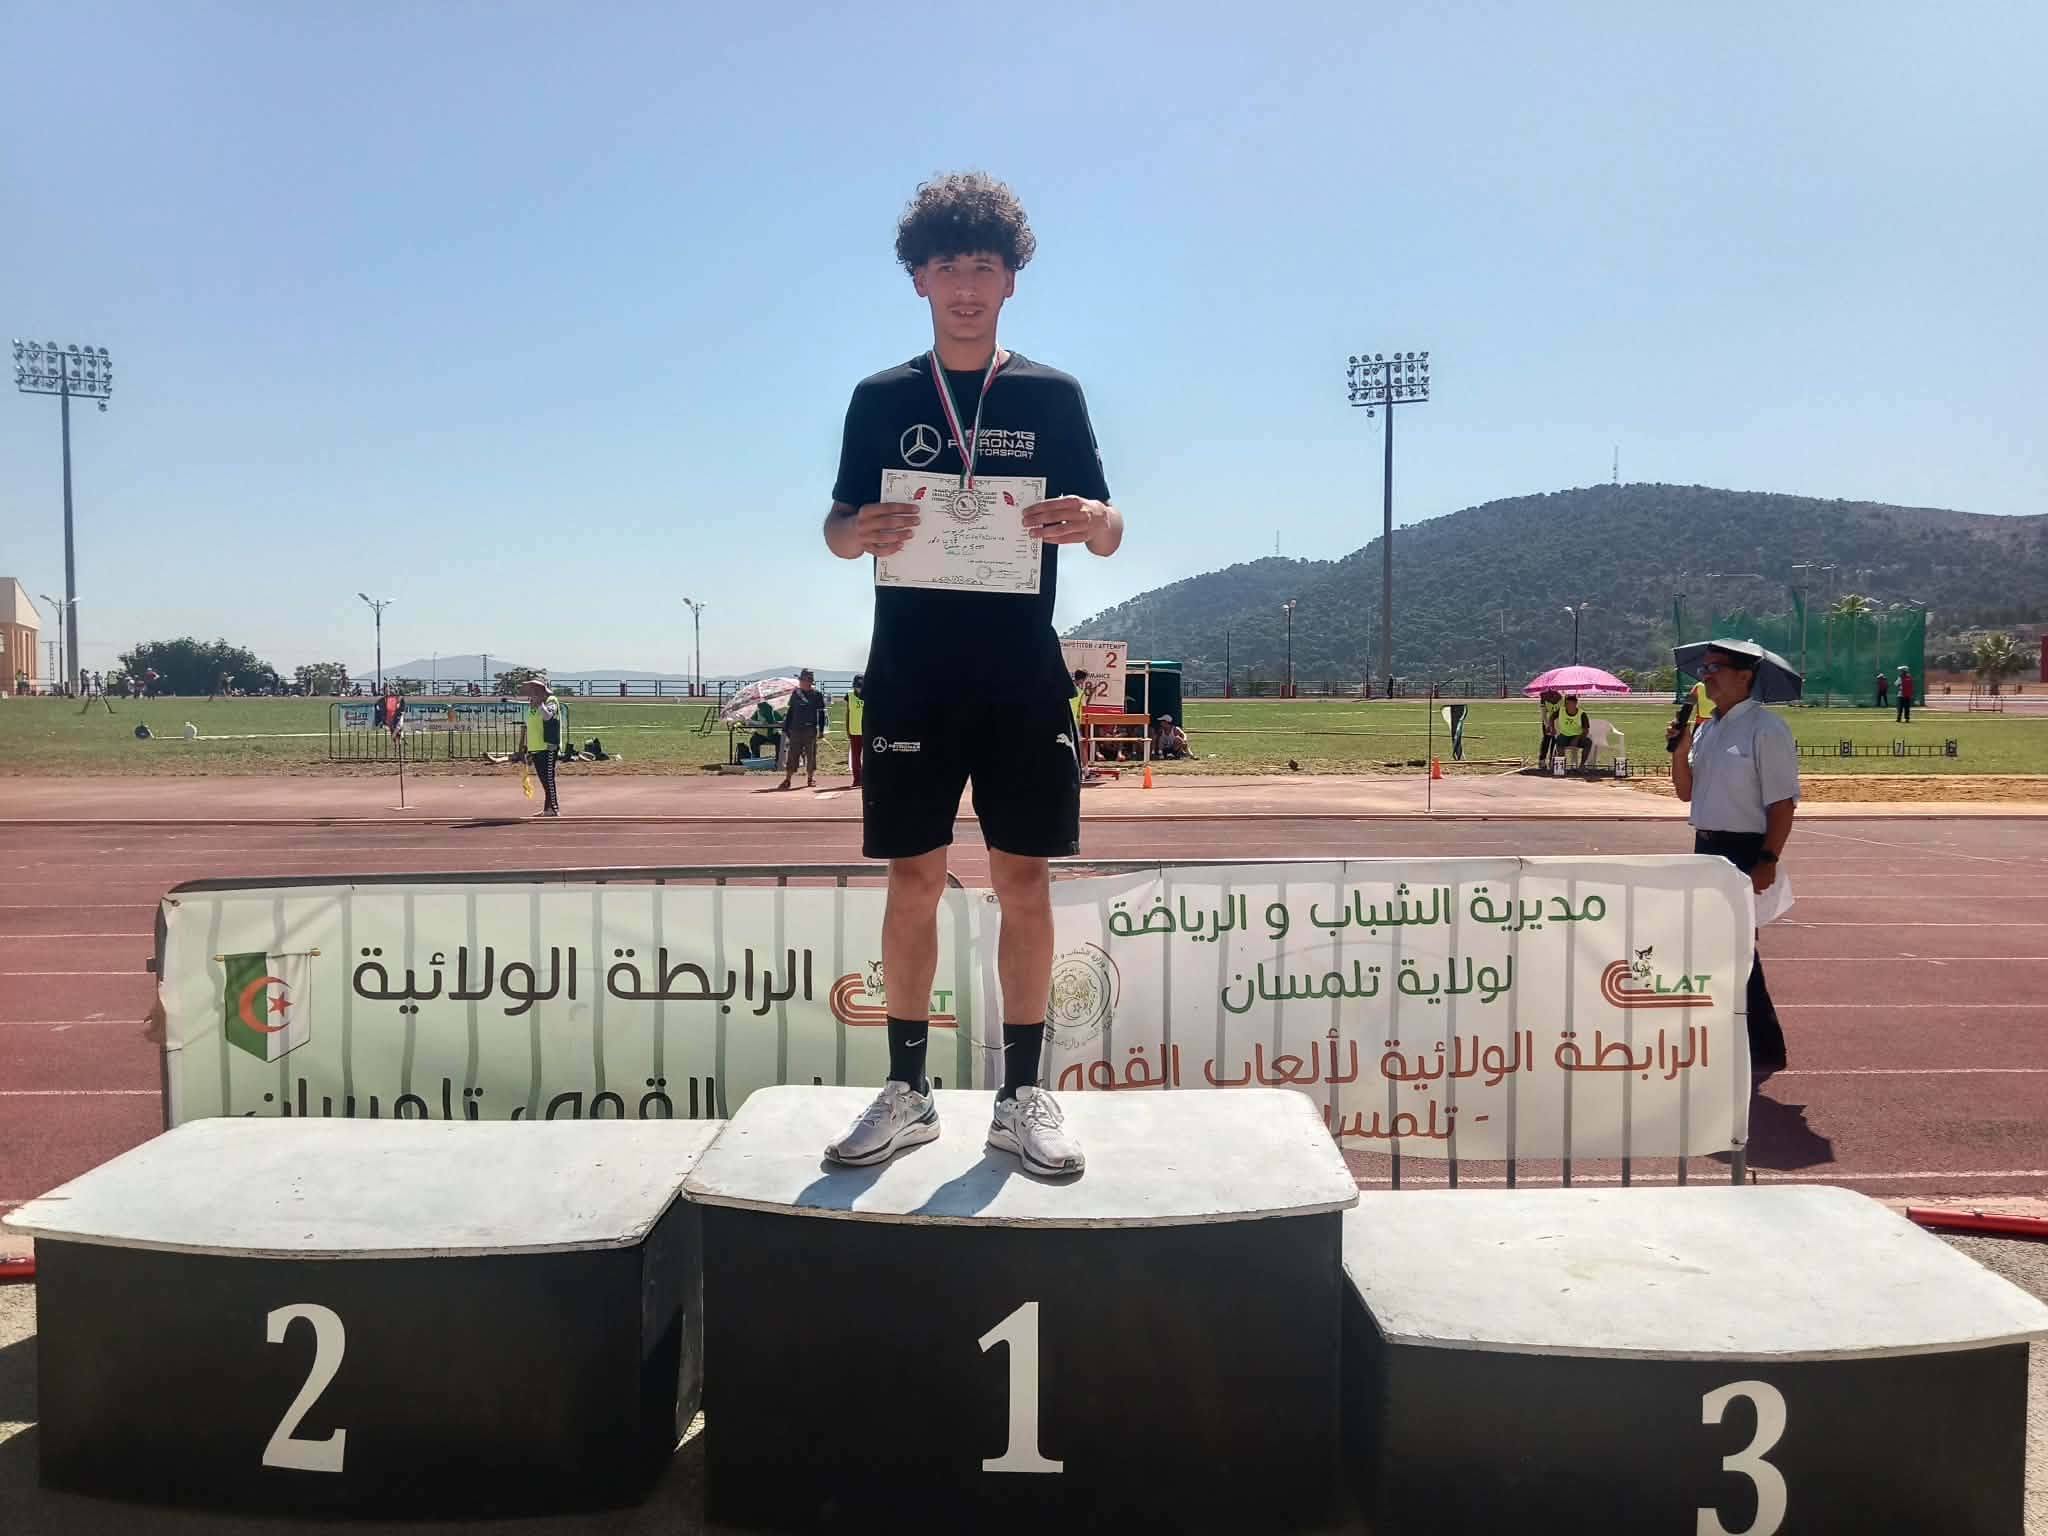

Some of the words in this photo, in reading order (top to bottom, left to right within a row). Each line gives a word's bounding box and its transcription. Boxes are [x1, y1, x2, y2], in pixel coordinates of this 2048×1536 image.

[948, 439, 1035, 450] PRONAS
[977, 448, 1034, 459] TORSPORT
[1106, 652, 1117, 668] 2
[1108, 893, 1247, 943] الرياضة
[1265, 902, 1290, 940] و
[1310, 883, 1451, 938] الشباب
[1470, 887, 1606, 931] مديرية
[352, 946, 577, 1016] الولائية
[606, 948, 814, 1016] الرابطة
[1221, 960, 1381, 1014] تلمسان
[1397, 954, 1513, 1004] لولاية
[1203, 1027, 1359, 1087] لألعاب
[1380, 1030, 1533, 1091] الولائية
[1554, 1025, 1708, 1081] الرابطة
[1323, 1099, 1458, 1139] تلمسا
[262, 1303, 347, 1473] 2
[977, 1301, 1064, 1473] 1
[1696, 1380, 1788, 1536] 3
